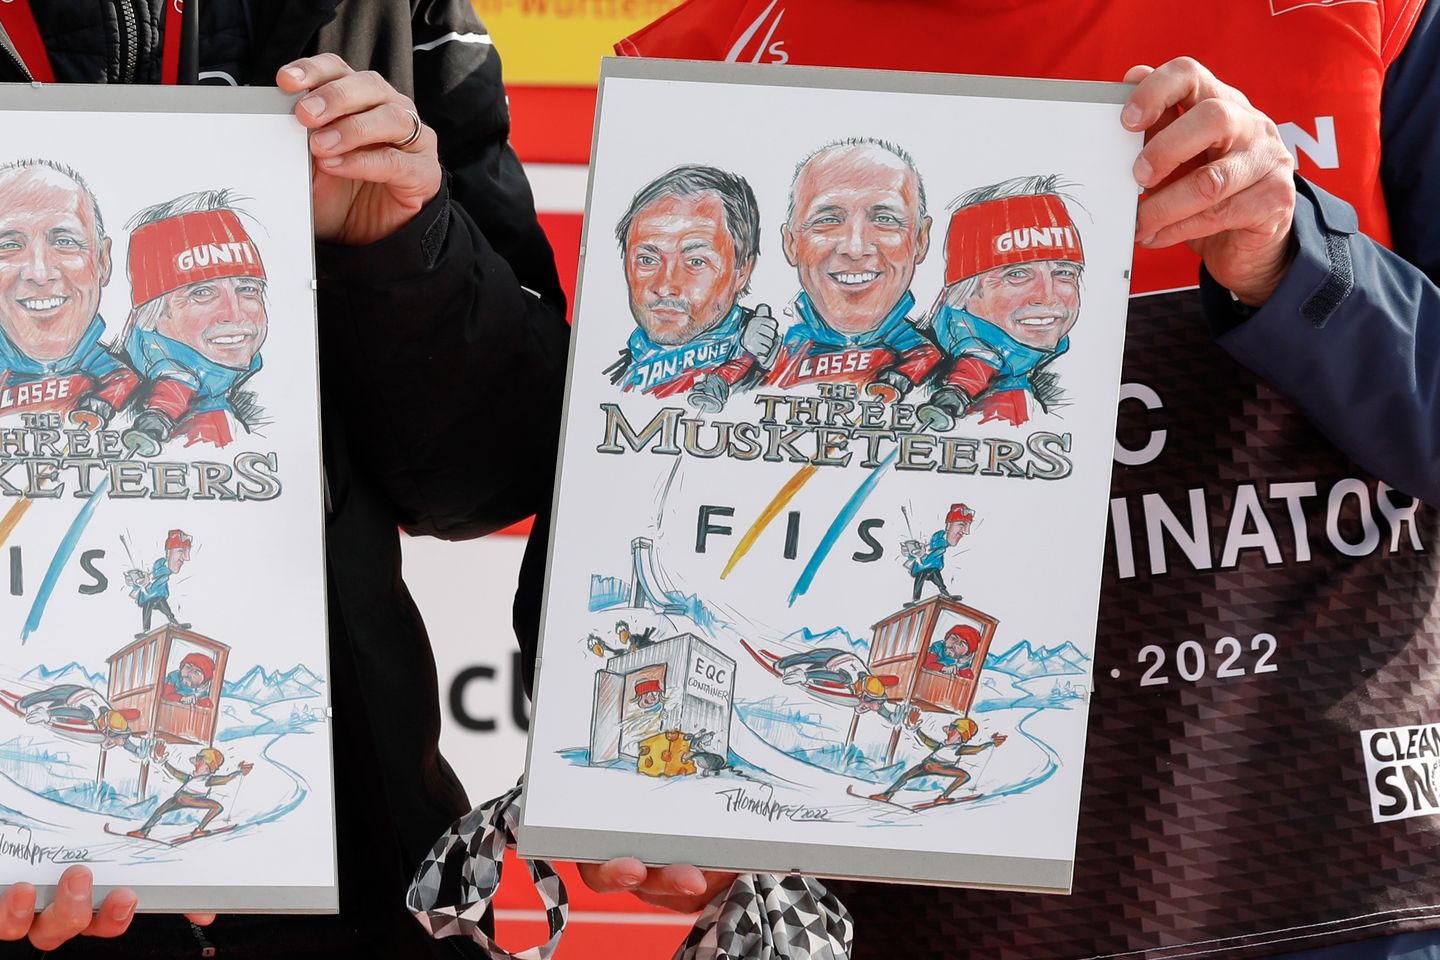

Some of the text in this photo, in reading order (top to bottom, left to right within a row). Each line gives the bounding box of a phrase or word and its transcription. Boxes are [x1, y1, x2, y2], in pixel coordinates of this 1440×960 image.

[997, 225, 1075, 253] GUNTI
[178, 242, 254, 272] GUNTI
[798, 350, 871, 379] LASSE
[0, 379, 71, 409] LASSE
[818, 383, 858, 400] THE
[21, 413, 60, 429] THE
[754, 394, 918, 431] THREE
[597, 401, 1072, 480] MUSKETEERS
[1110, 477, 1425, 578] INATOR
[1138, 633, 1279, 687] 2022
